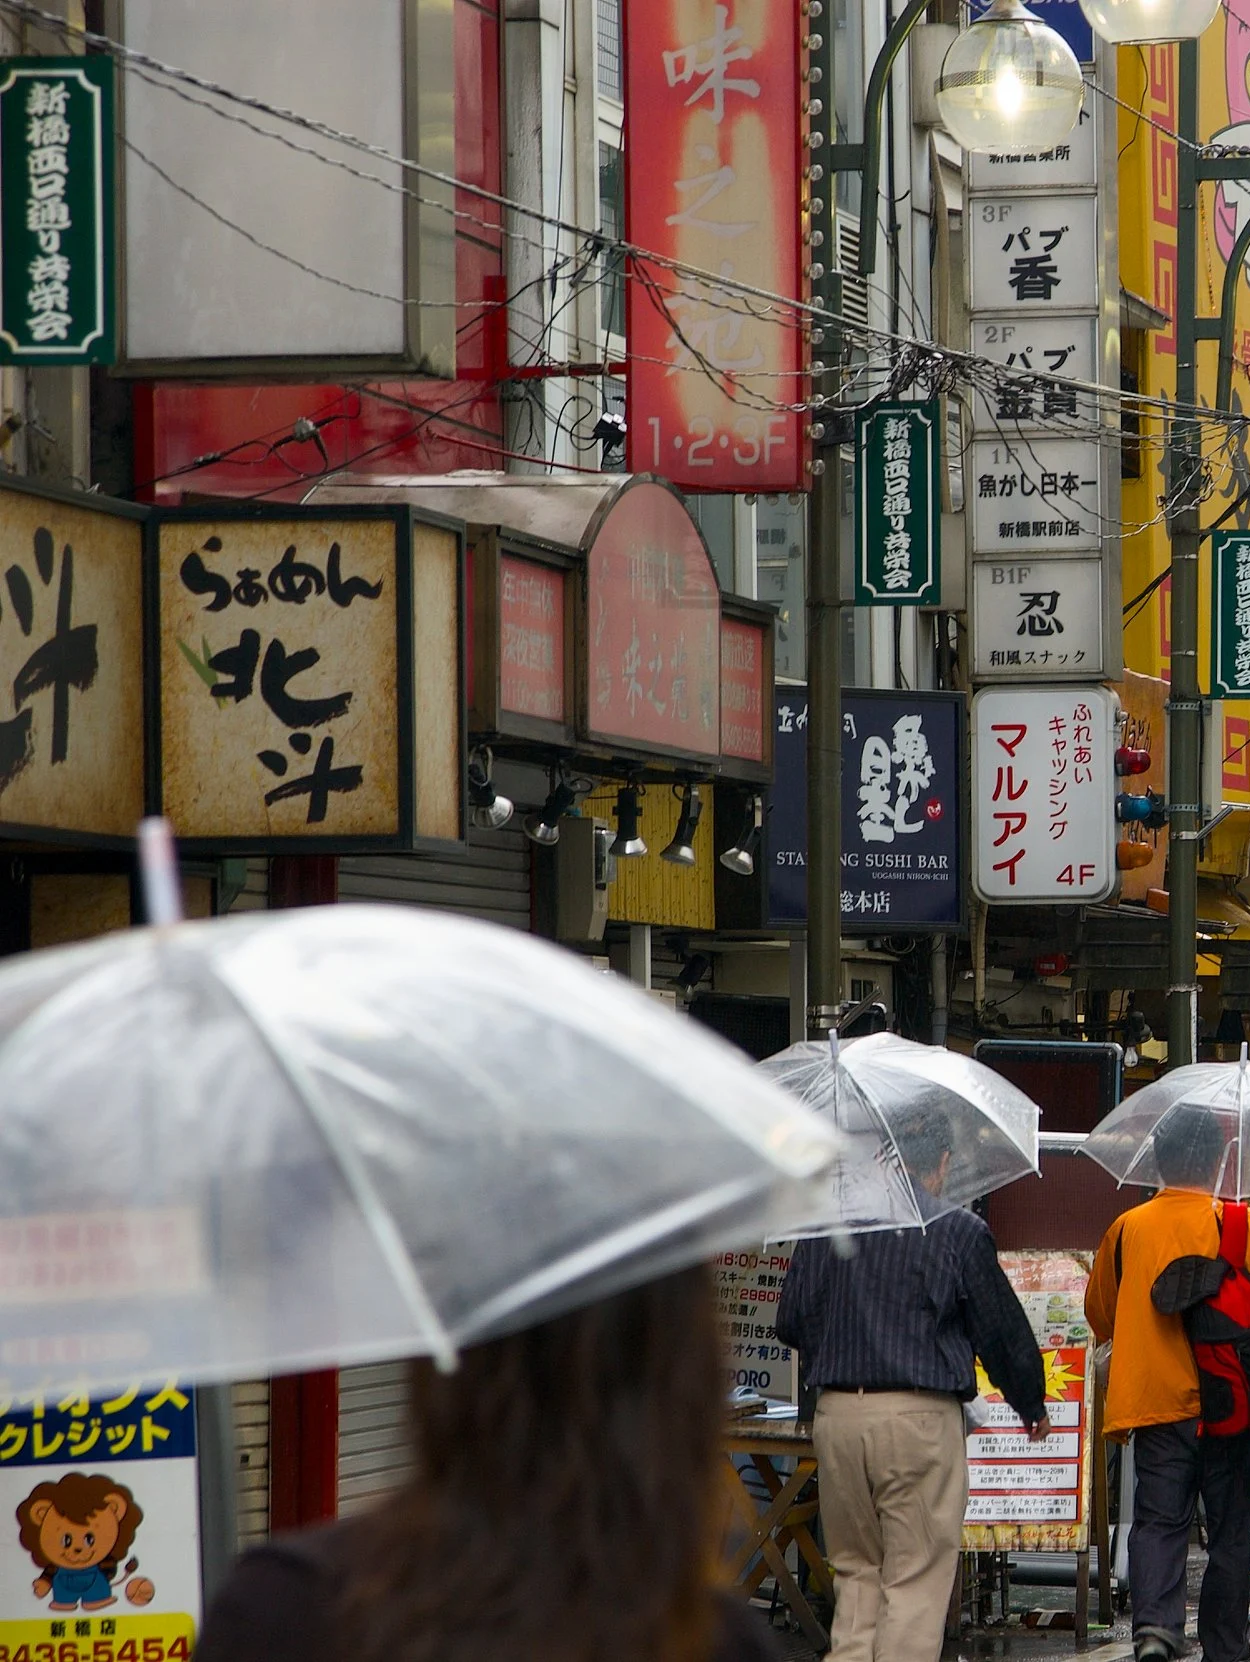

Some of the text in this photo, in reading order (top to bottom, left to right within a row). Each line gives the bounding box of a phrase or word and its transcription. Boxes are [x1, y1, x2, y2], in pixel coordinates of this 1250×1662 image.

[27, 82, 72, 341] 新橋西口通り共栄会
[982, 206, 1012, 223] 3F
[1002, 226, 1069, 253] パブ
[1009, 254, 1061, 301] 香
[984, 326, 1016, 344] 2F
[1006, 345, 1075, 371] パブ
[978, 471, 1097, 498] 魚がし日本一
[883, 418, 912, 592] 新橋西口通り共栄会
[999, 520, 1080, 538] 新橋駅前店
[180, 536, 383, 611] らぁめん
[991, 568, 1031, 585] B1F
[1017, 591, 1064, 636] 忍
[989, 650, 1086, 667] 和風スナック
[209, 628, 363, 824] 北斗
[1073, 704, 1092, 784] ふれあい
[1049, 716, 1068, 840] キャッシング
[991, 723, 1028, 886] マルアイ
[865, 855, 911, 868] SUSHI
[918, 855, 948, 868] BAR
[1056, 864, 1096, 887] 4F
[51, 1619, 116, 1638] 新橋店
